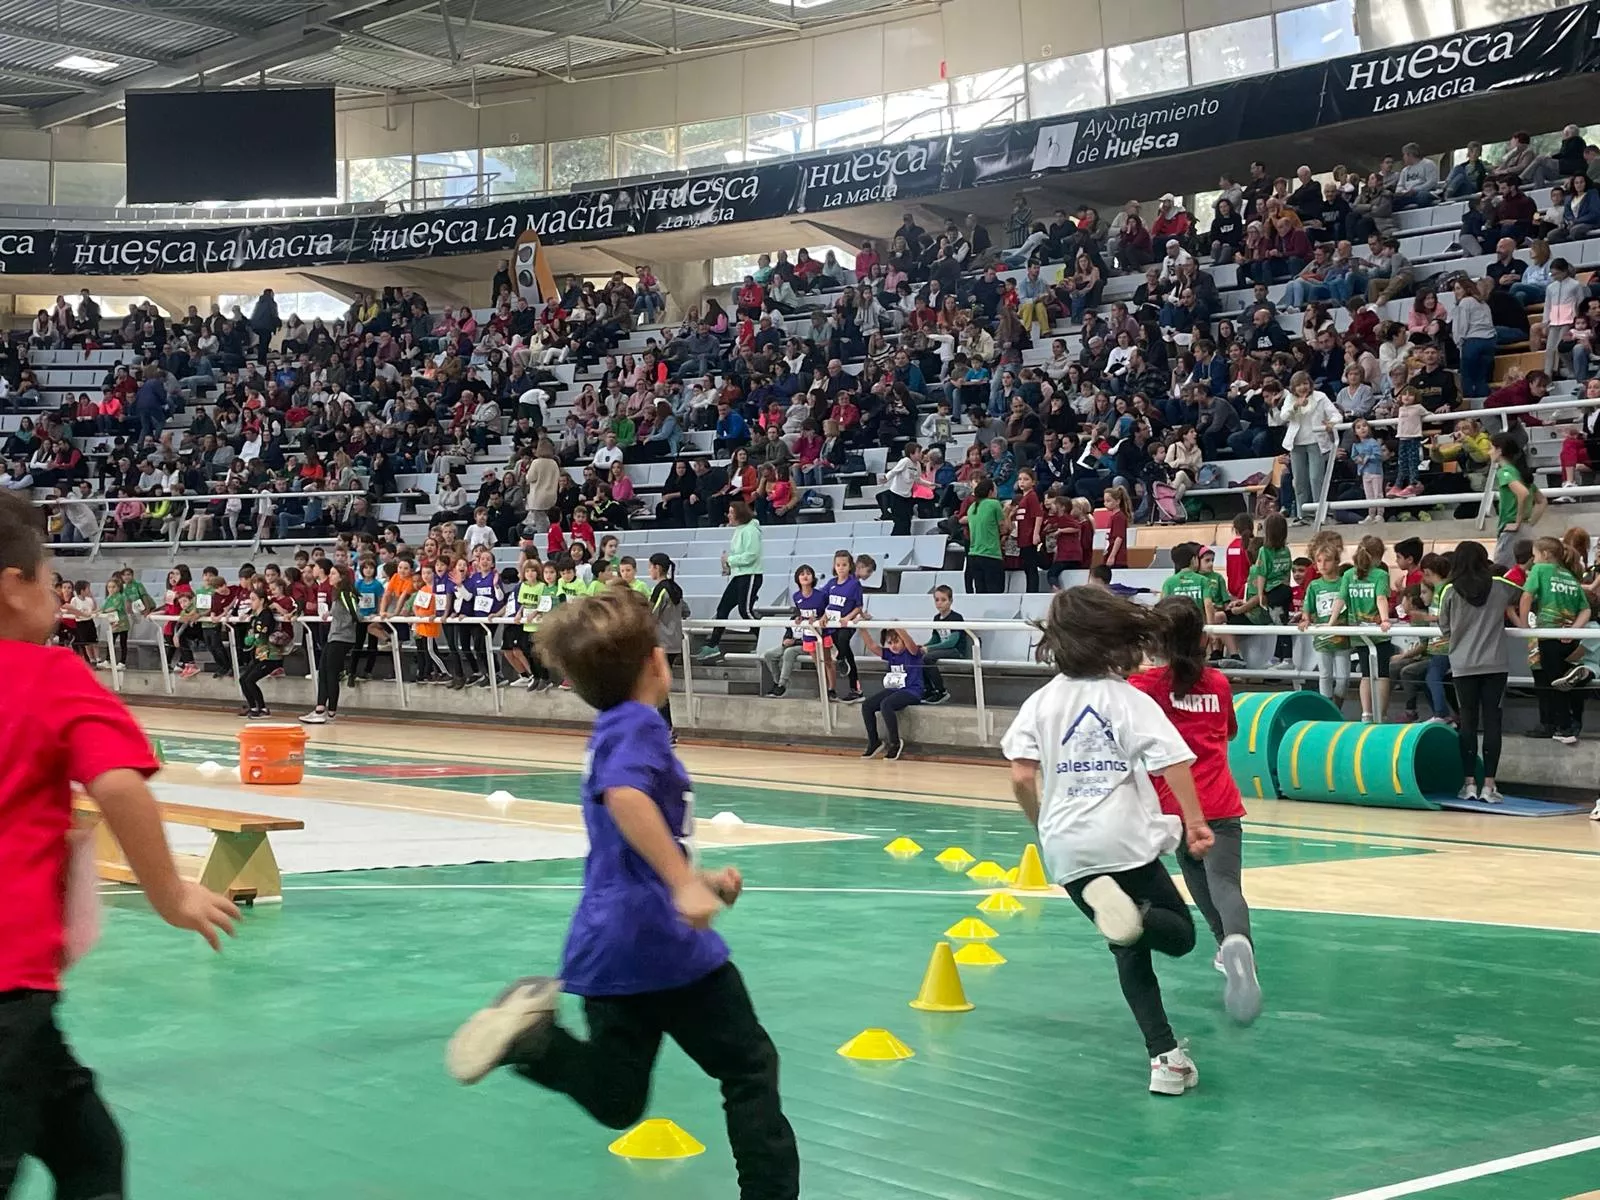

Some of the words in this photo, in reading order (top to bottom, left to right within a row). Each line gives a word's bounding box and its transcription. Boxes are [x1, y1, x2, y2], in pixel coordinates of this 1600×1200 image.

[1082, 98, 1219, 141] Ayuntamiento
[1076, 145, 1099, 164] de
[1104, 130, 1179, 160] Huesca
